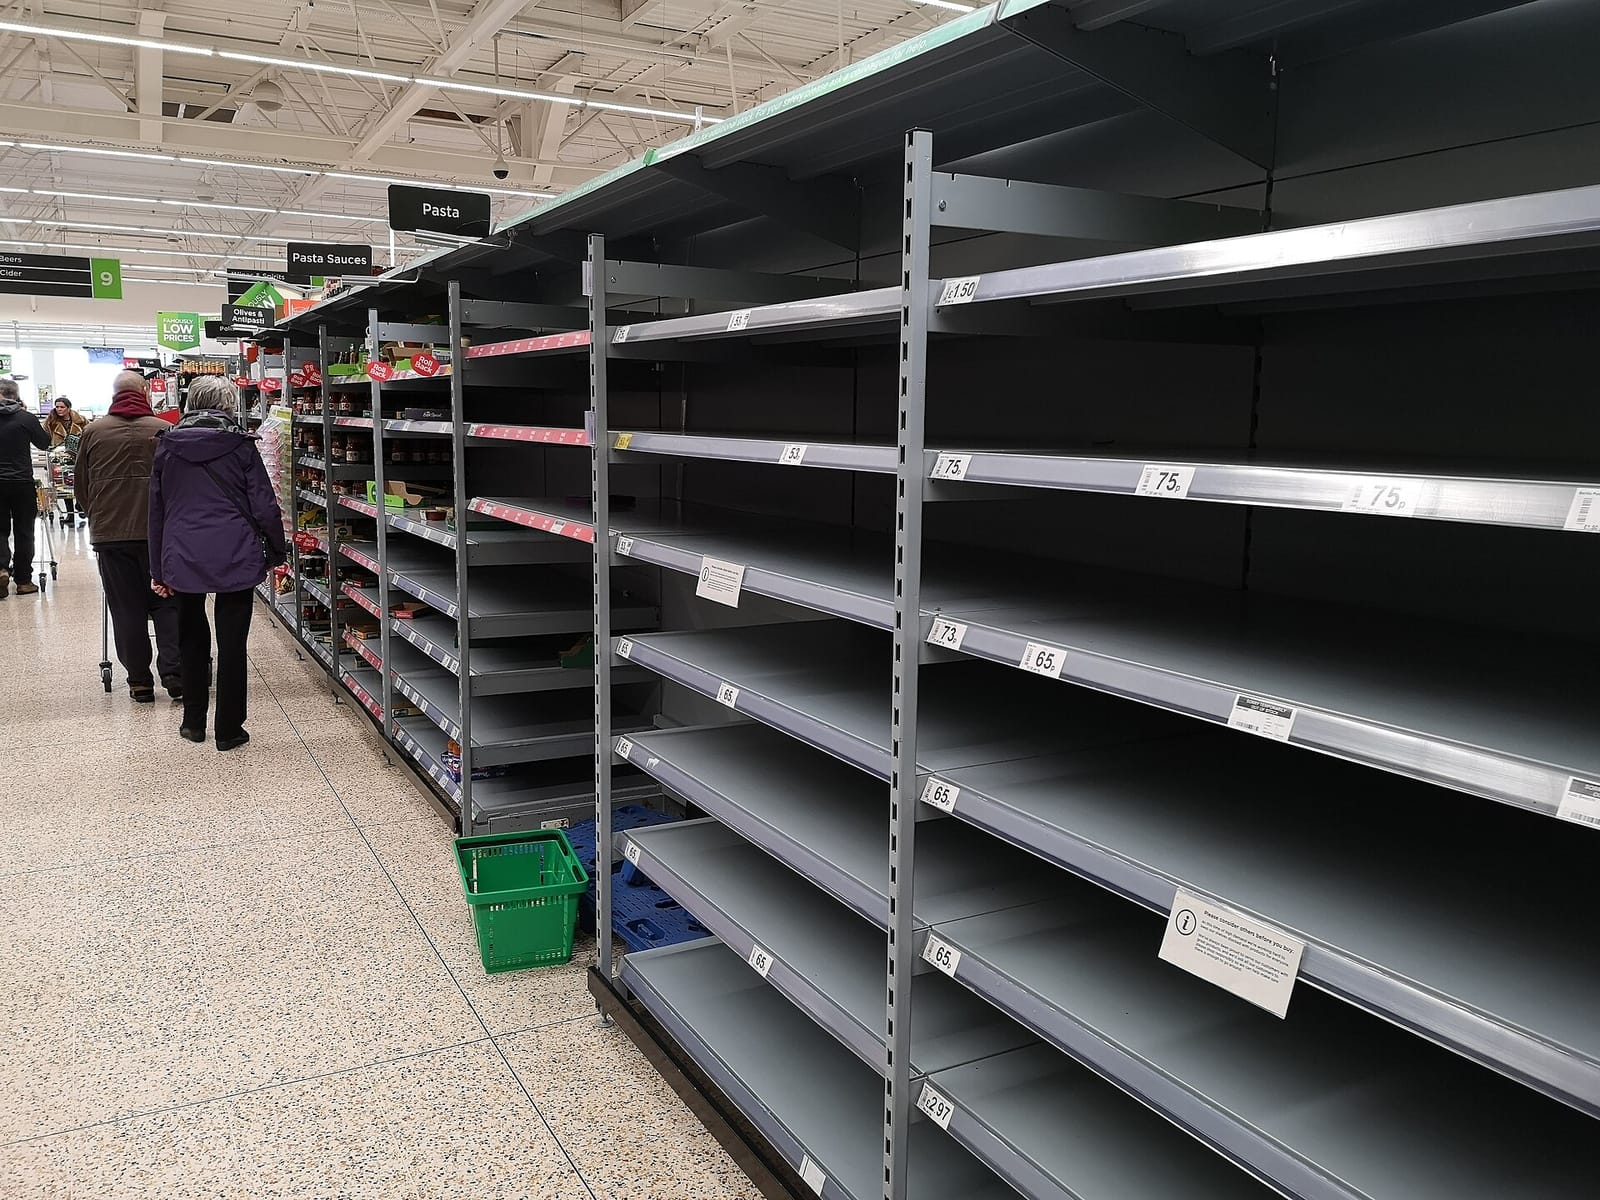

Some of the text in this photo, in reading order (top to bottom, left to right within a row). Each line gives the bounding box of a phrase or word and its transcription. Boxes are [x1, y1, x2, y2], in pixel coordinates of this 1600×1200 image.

[422, 202, 460, 218] Pasta
[292, 252, 367, 265] Pasta Sauces
[100, 271, 113, 286] 9
[948, 282, 976, 298] £1.50
[232, 316, 265, 325] Antipasti
[233, 309, 256, 317] Olives
[163, 324, 193, 334] LOW
[163, 334, 194, 342] PRICES
[374, 364, 386, 374] Roll
[415, 362, 433, 374] Back
[420, 356, 434, 367] Roll
[370, 368, 387, 379] Back
[1156, 472, 1180, 493] 75p
[1370, 485, 1406, 510] 75p
[1035, 650, 1056, 672] 65p
[934, 786, 950, 806] 65p
[1204, 911, 1218, 920] Please
[1219, 917, 1239, 929] consider
[1240, 926, 1255, 936] others
[1255, 933, 1272, 944] before
[1282, 946, 1294, 954] buy.
[936, 946, 952, 969] 65p
[926, 1096, 950, 1120] £2.97
